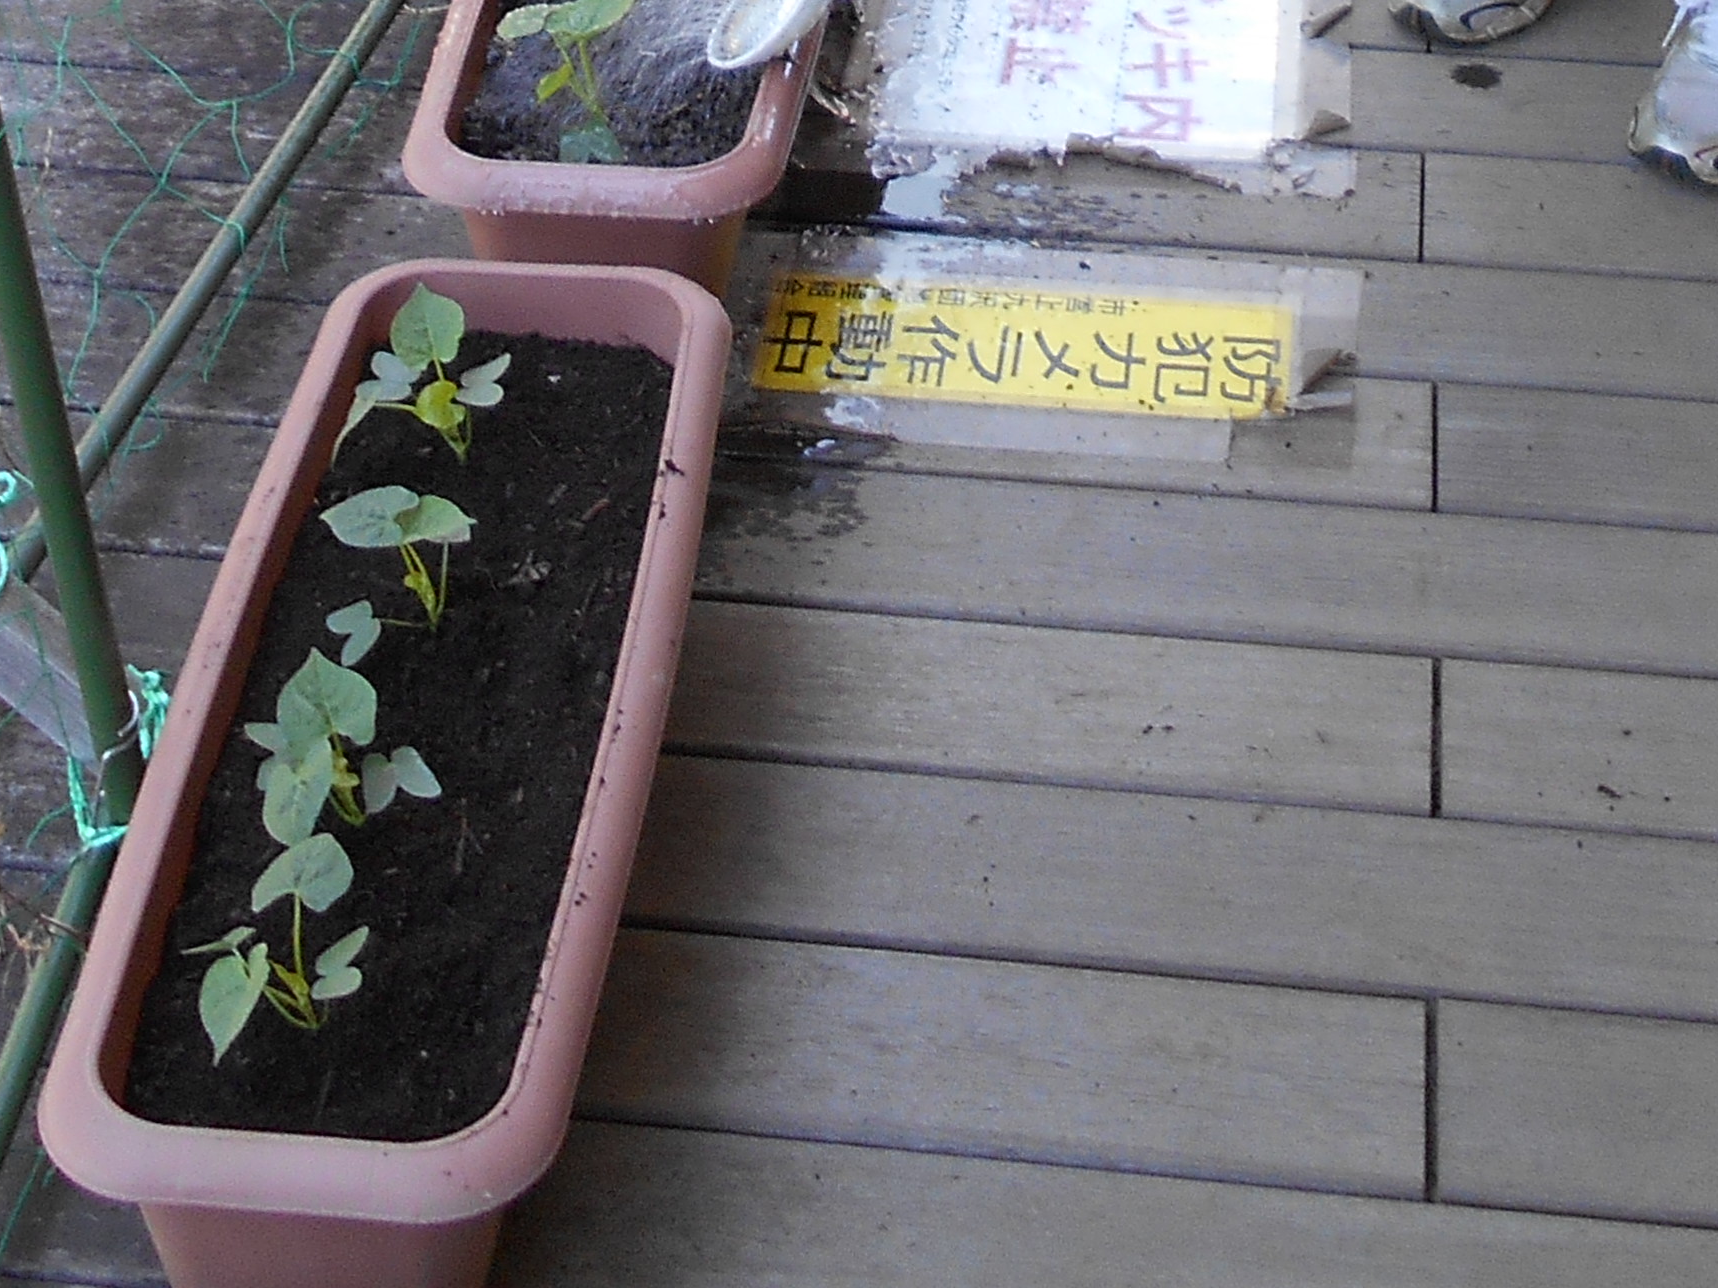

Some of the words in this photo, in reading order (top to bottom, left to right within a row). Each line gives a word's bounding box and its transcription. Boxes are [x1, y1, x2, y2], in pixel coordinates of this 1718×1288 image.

[760, 310, 1283, 405] 防犯カメラ作動中
